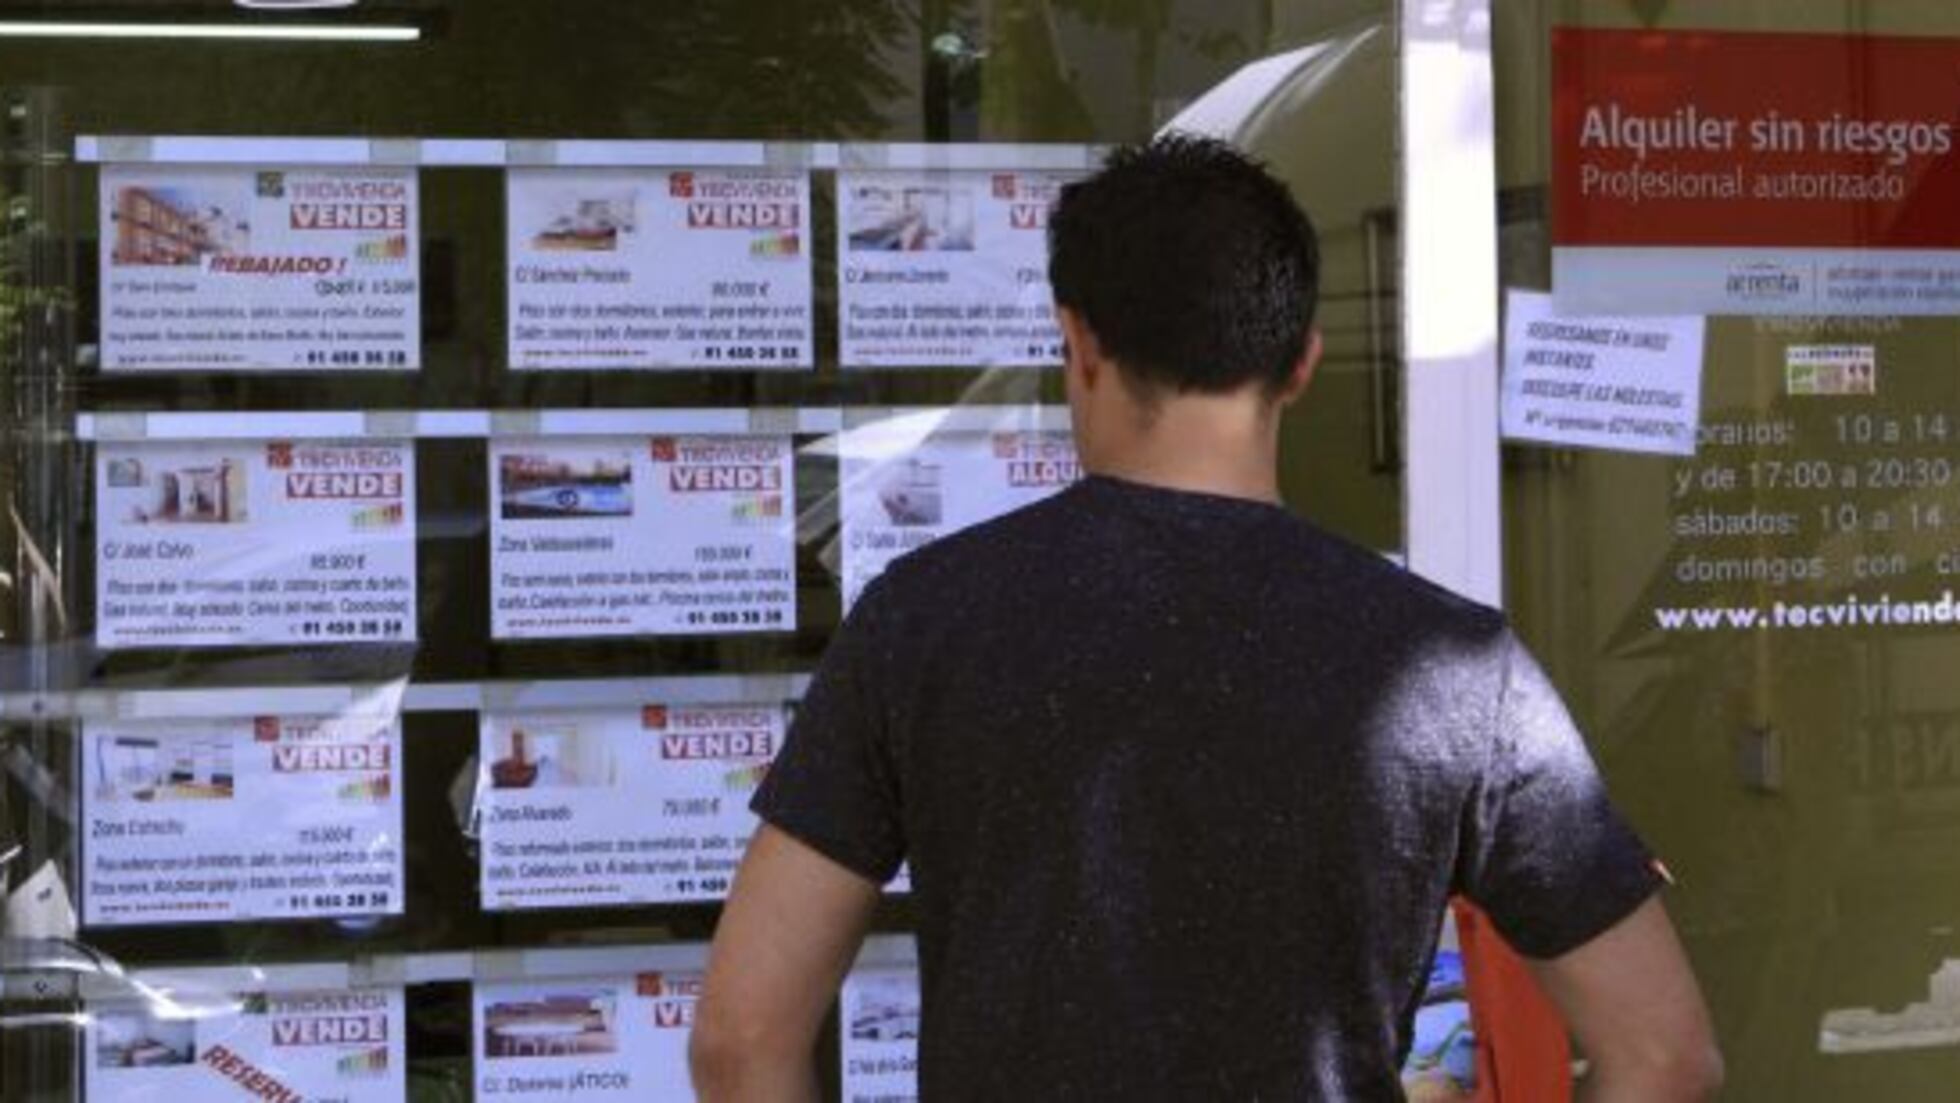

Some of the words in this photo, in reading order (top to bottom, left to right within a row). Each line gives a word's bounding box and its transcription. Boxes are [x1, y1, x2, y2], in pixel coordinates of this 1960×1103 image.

[1580, 103, 1737, 160] Alquiler
[1751, 110, 1803, 150] sin
[1819, 114, 1950, 164] riesgos
[1582, 165, 1742, 203] Profesional
[1755, 169, 1903, 200] autorizado
[292, 206, 404, 227] VENDE
[691, 206, 793, 227] VENDE
[209, 256, 331, 274] REBAJADO
[1695, 421, 1796, 445] orarios:
[1835, 414, 1872, 443] 10
[1883, 420, 1899, 442] a
[1914, 413, 1947, 442] 14
[289, 473, 399, 496] VENDE
[672, 467, 777, 490] VENDE
[1011, 464, 1082, 485] ALQU
[1675, 466, 1693, 498] y
[1701, 463, 1736, 491] de
[1750, 459, 1832, 488] 17:00
[1841, 464, 1857, 488] a
[1866, 458, 1951, 488] 20:30
[1820, 503, 1858, 532] 10
[1872, 510, 1890, 531] a
[1911, 503, 1944, 532] 14
[1676, 553, 1825, 584] domingos
[1854, 553, 1907, 577] con
[277, 746, 386, 770] VENDE
[665, 733, 769, 758] VENDE
[274, 1016, 385, 1044] VENDE
[202, 1044, 303, 1103] RESERV
